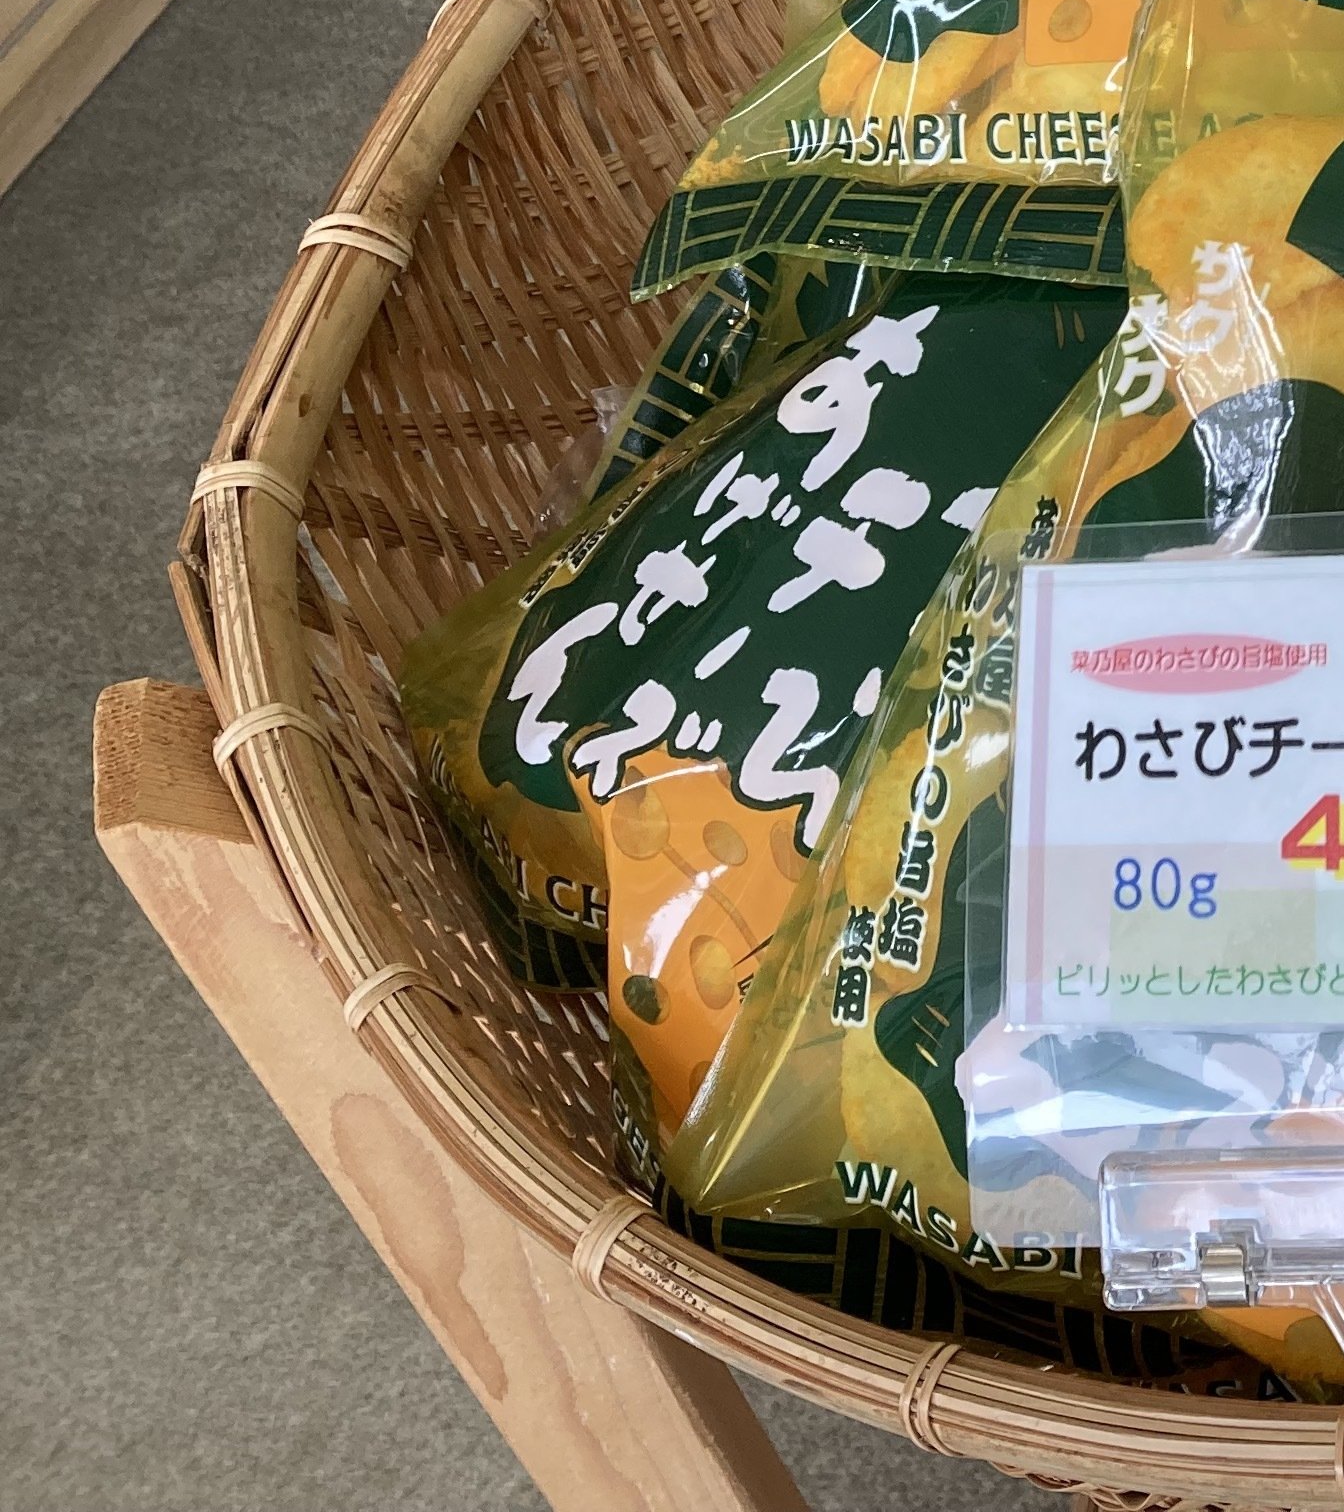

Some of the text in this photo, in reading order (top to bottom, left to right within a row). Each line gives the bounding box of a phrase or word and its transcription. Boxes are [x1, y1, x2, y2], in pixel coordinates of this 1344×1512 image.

[785, 111, 967, 167] WASABI
[1070, 642, 1328, 675] 菜乃屋のわさびの旨塩使用
[1113, 857, 1219, 920] 80g
[834, 1160, 1084, 1280] WASABI
